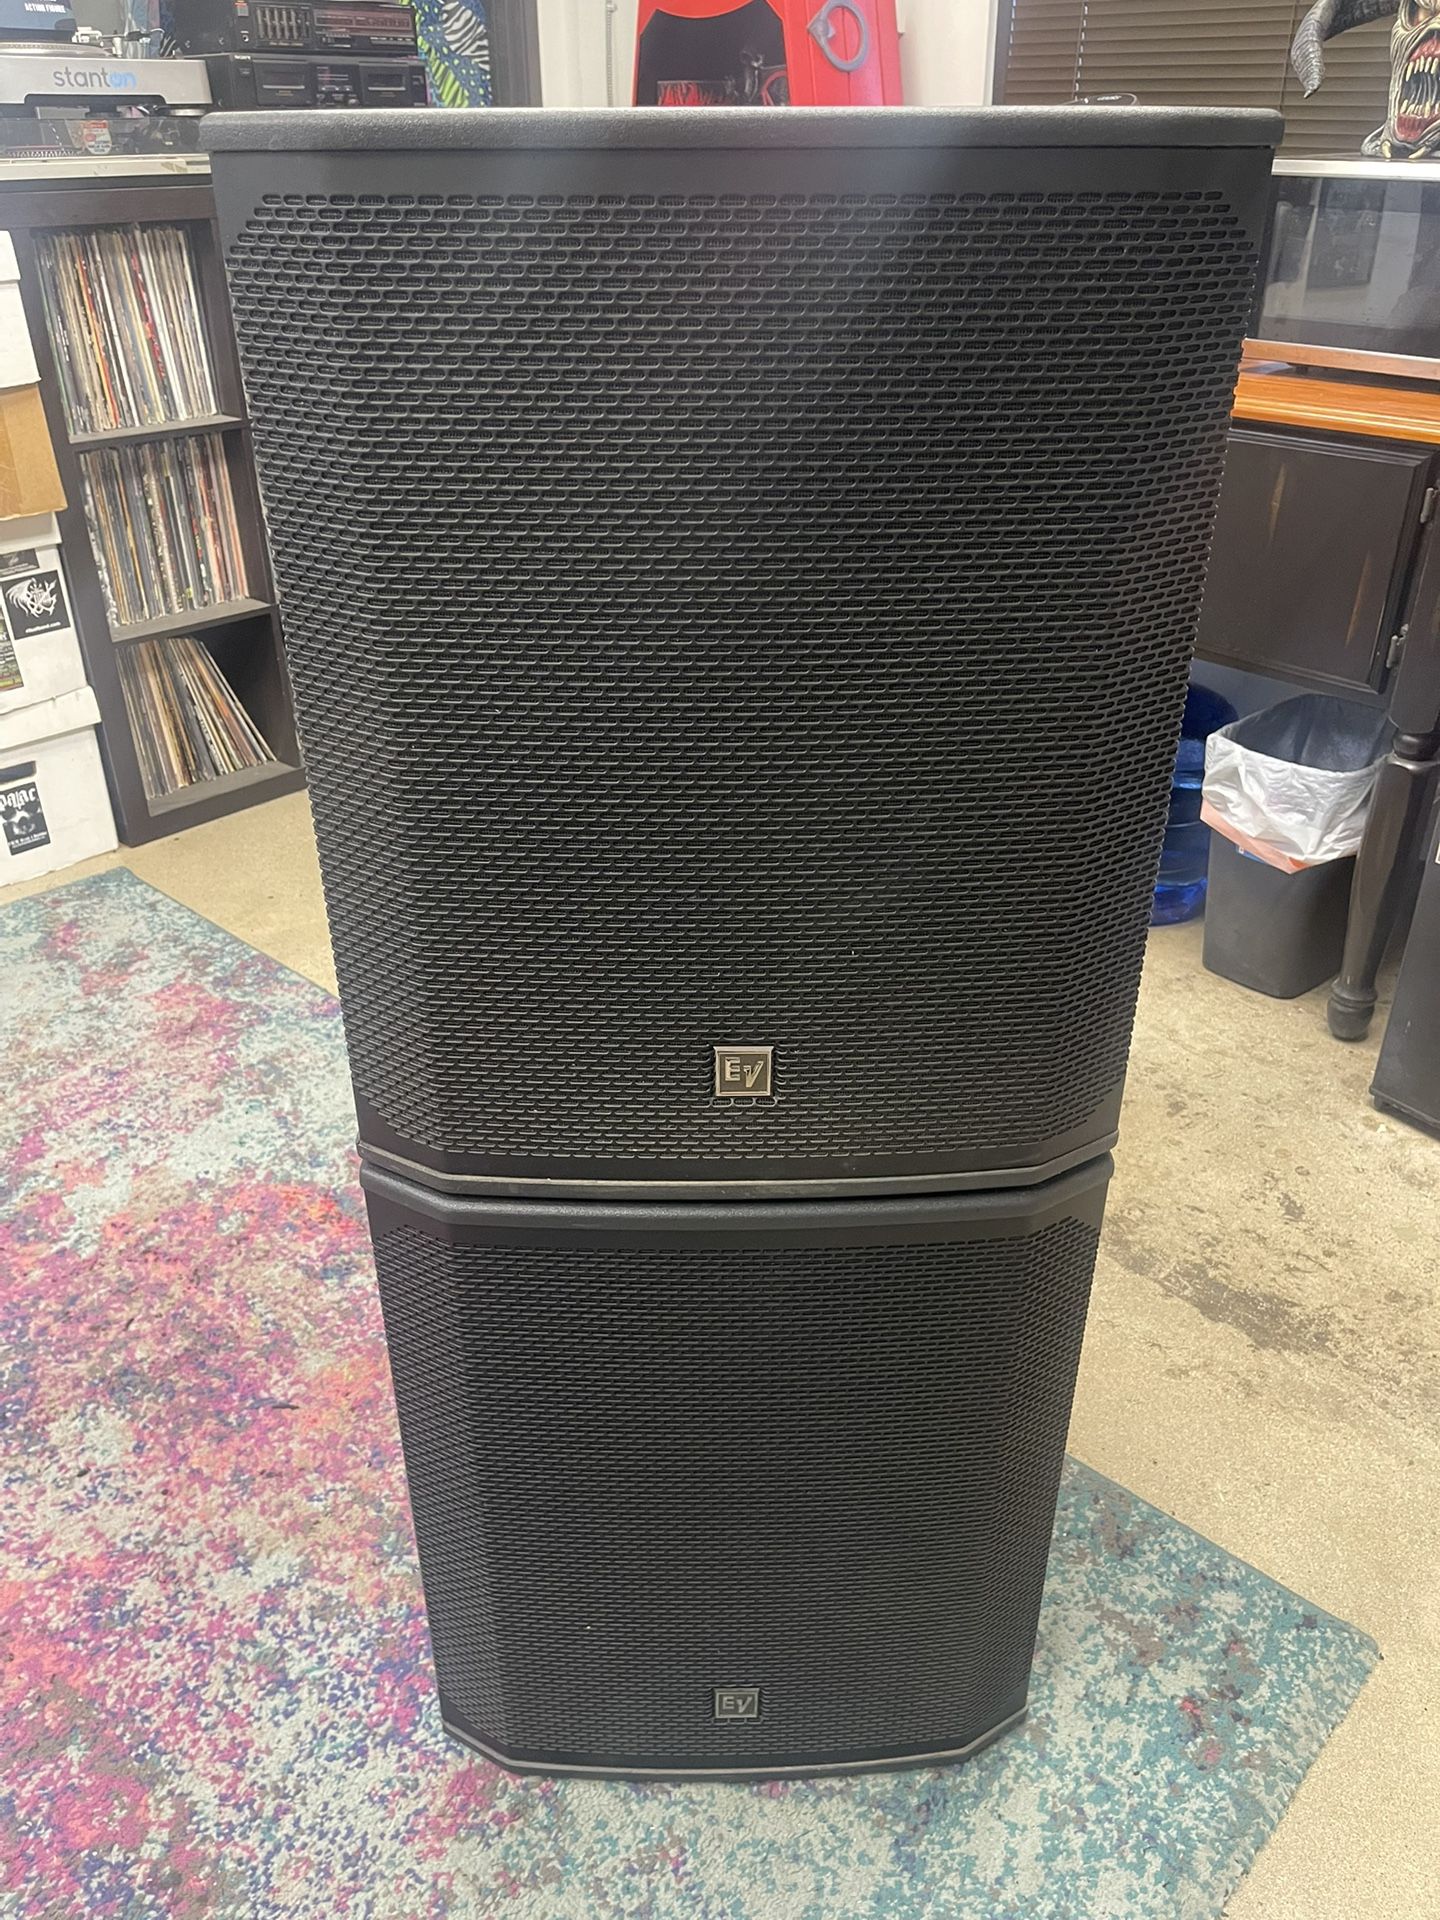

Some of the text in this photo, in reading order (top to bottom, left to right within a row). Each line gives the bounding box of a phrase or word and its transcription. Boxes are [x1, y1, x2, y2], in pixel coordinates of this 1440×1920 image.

[53, 66, 137, 89] stanton
[724, 1056, 764, 1088] EV
[722, 1695, 753, 1713] EV
